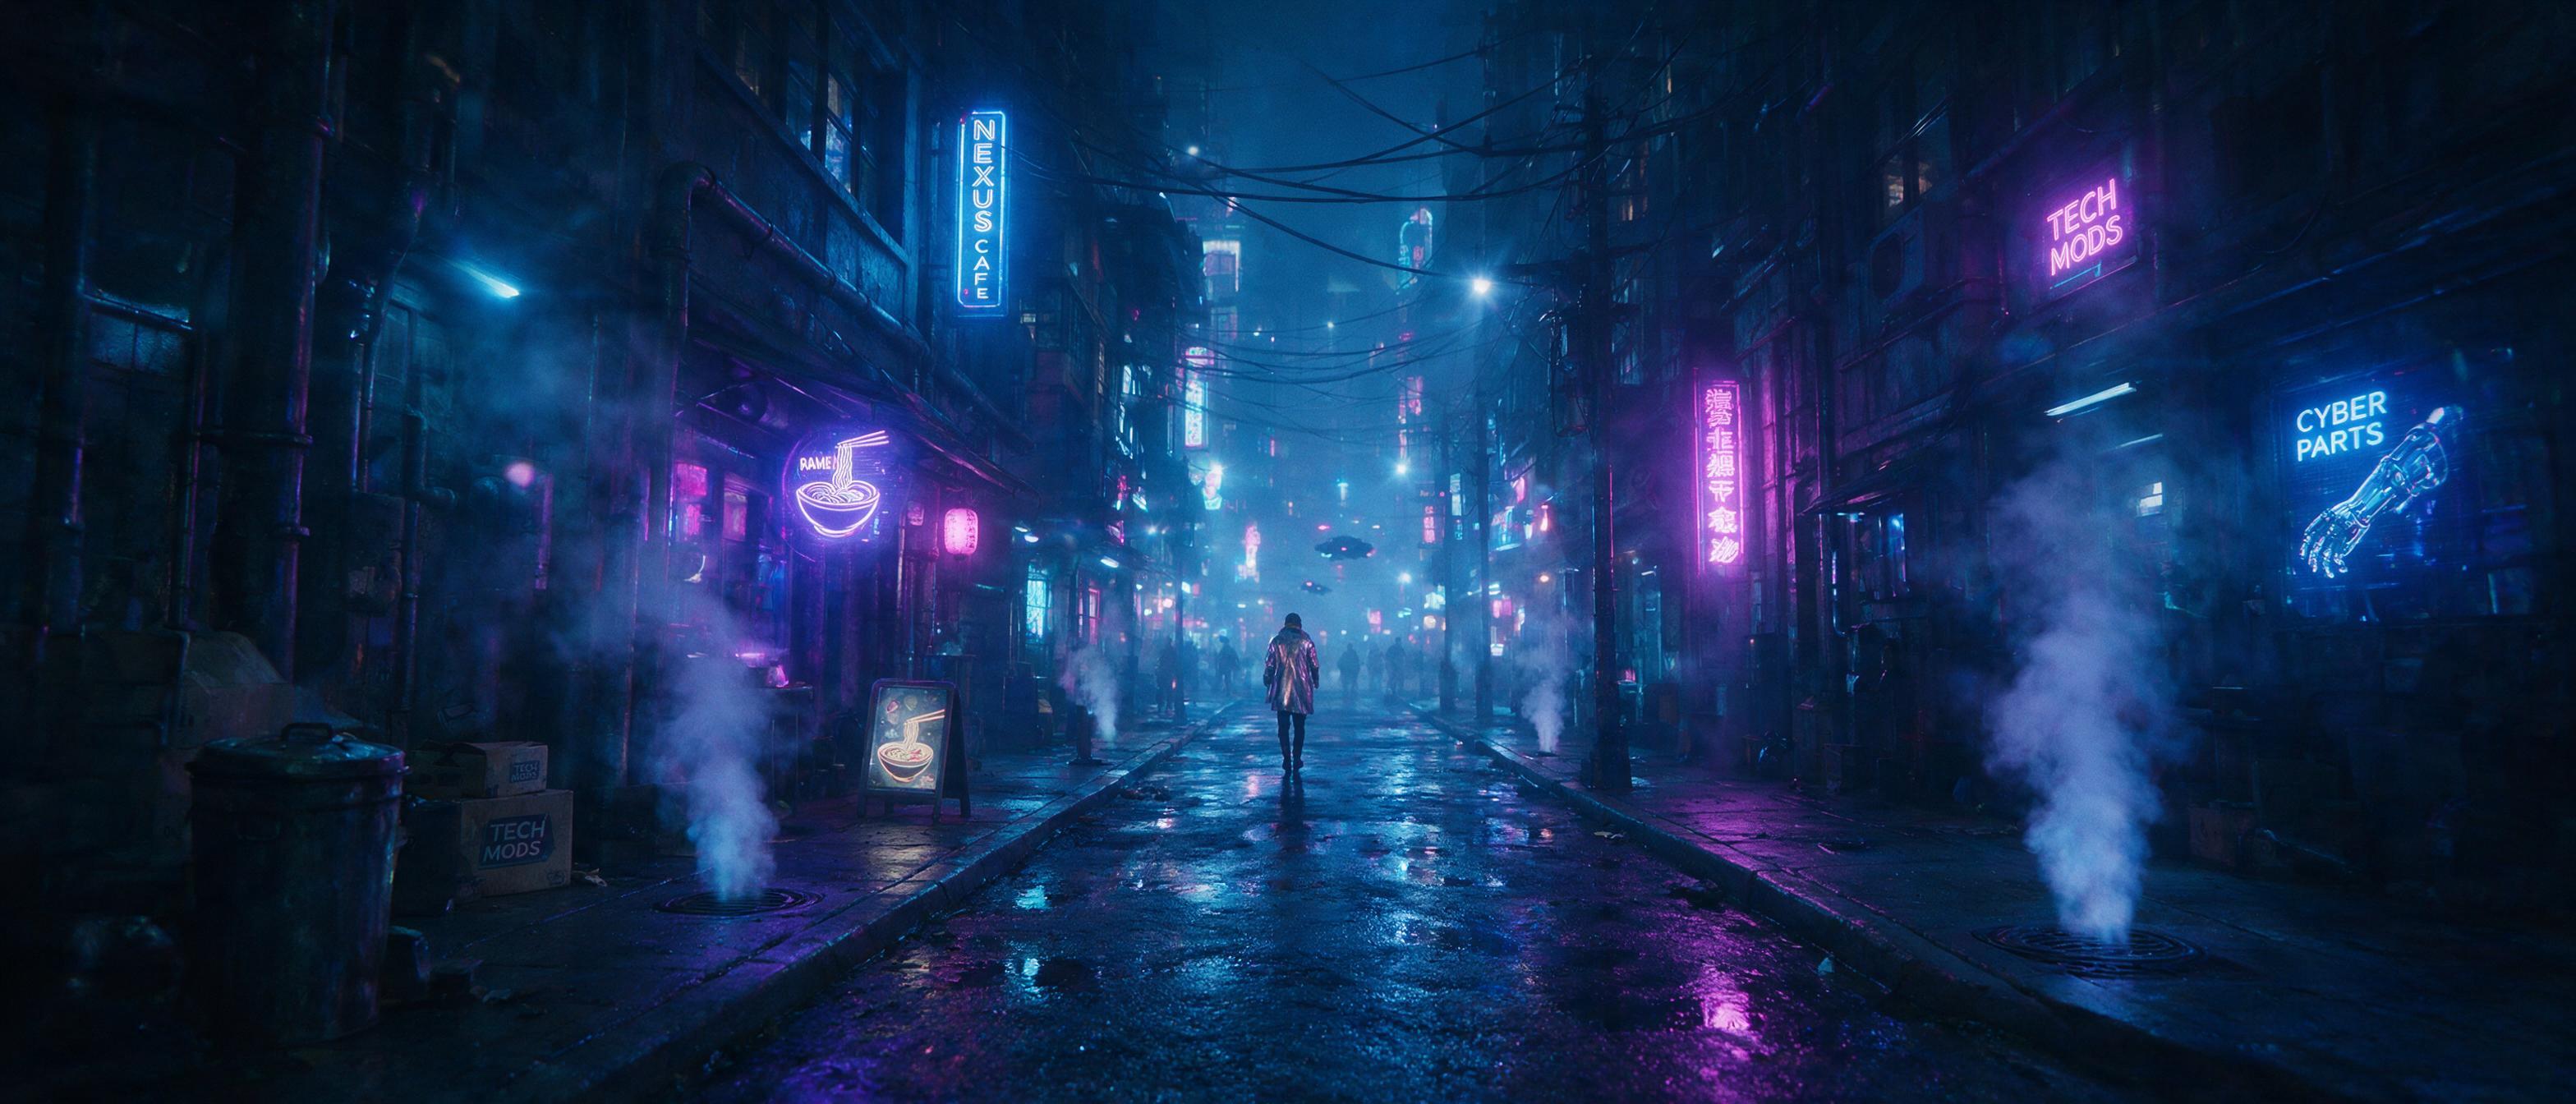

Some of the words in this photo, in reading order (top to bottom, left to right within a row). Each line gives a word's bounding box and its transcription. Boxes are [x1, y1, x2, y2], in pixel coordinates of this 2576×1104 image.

[972, 119, 995, 232] NEXUS
[2047, 178, 2117, 241] TECH
[2050, 214, 2123, 276] MODS
[973, 239, 990, 299] CAFE
[2297, 391, 2387, 433] CYBER
[2297, 421, 2384, 462] PARTS
[513, 762, 539, 775] TECH
[482, 841, 541, 862] MODS
[490, 820, 546, 842] TECH
